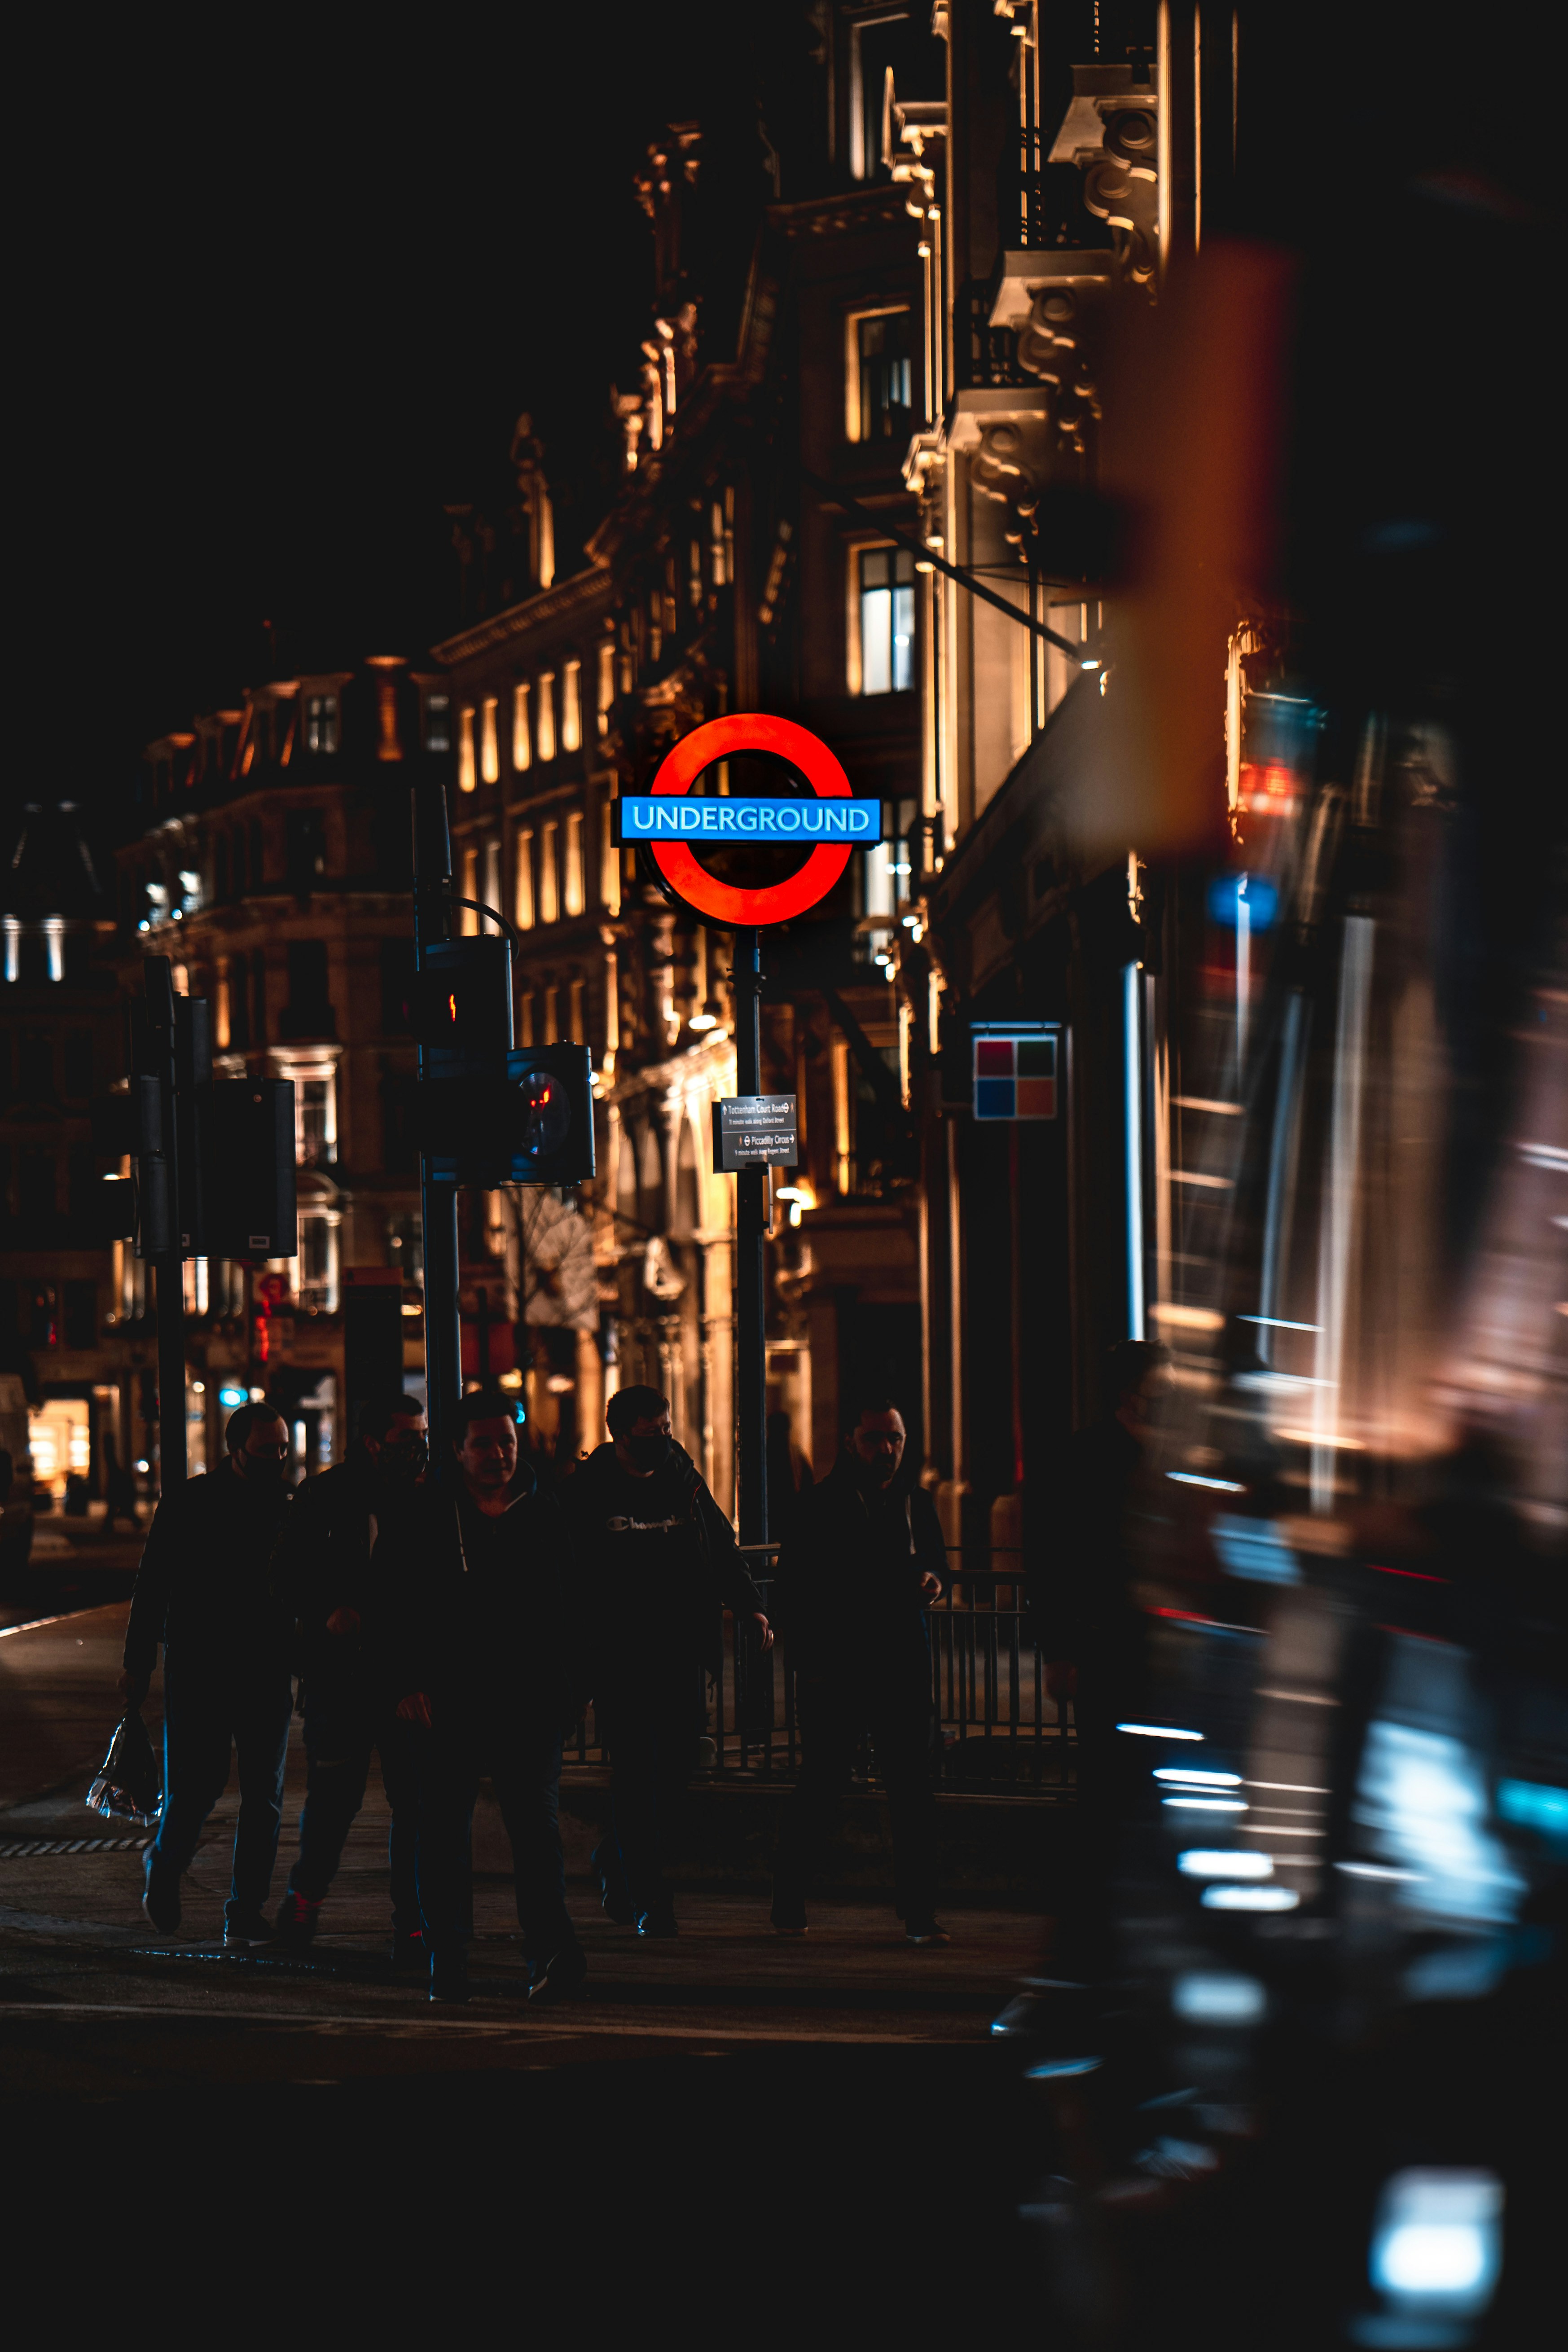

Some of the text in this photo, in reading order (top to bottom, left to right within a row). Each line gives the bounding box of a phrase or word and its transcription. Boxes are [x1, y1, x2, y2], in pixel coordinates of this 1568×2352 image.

[633, 805, 869, 832] UNDERGROUND
[728, 1104, 784, 1115] Tottenham Court Road
[751, 1135, 790, 1146] Piccadilly Circus
